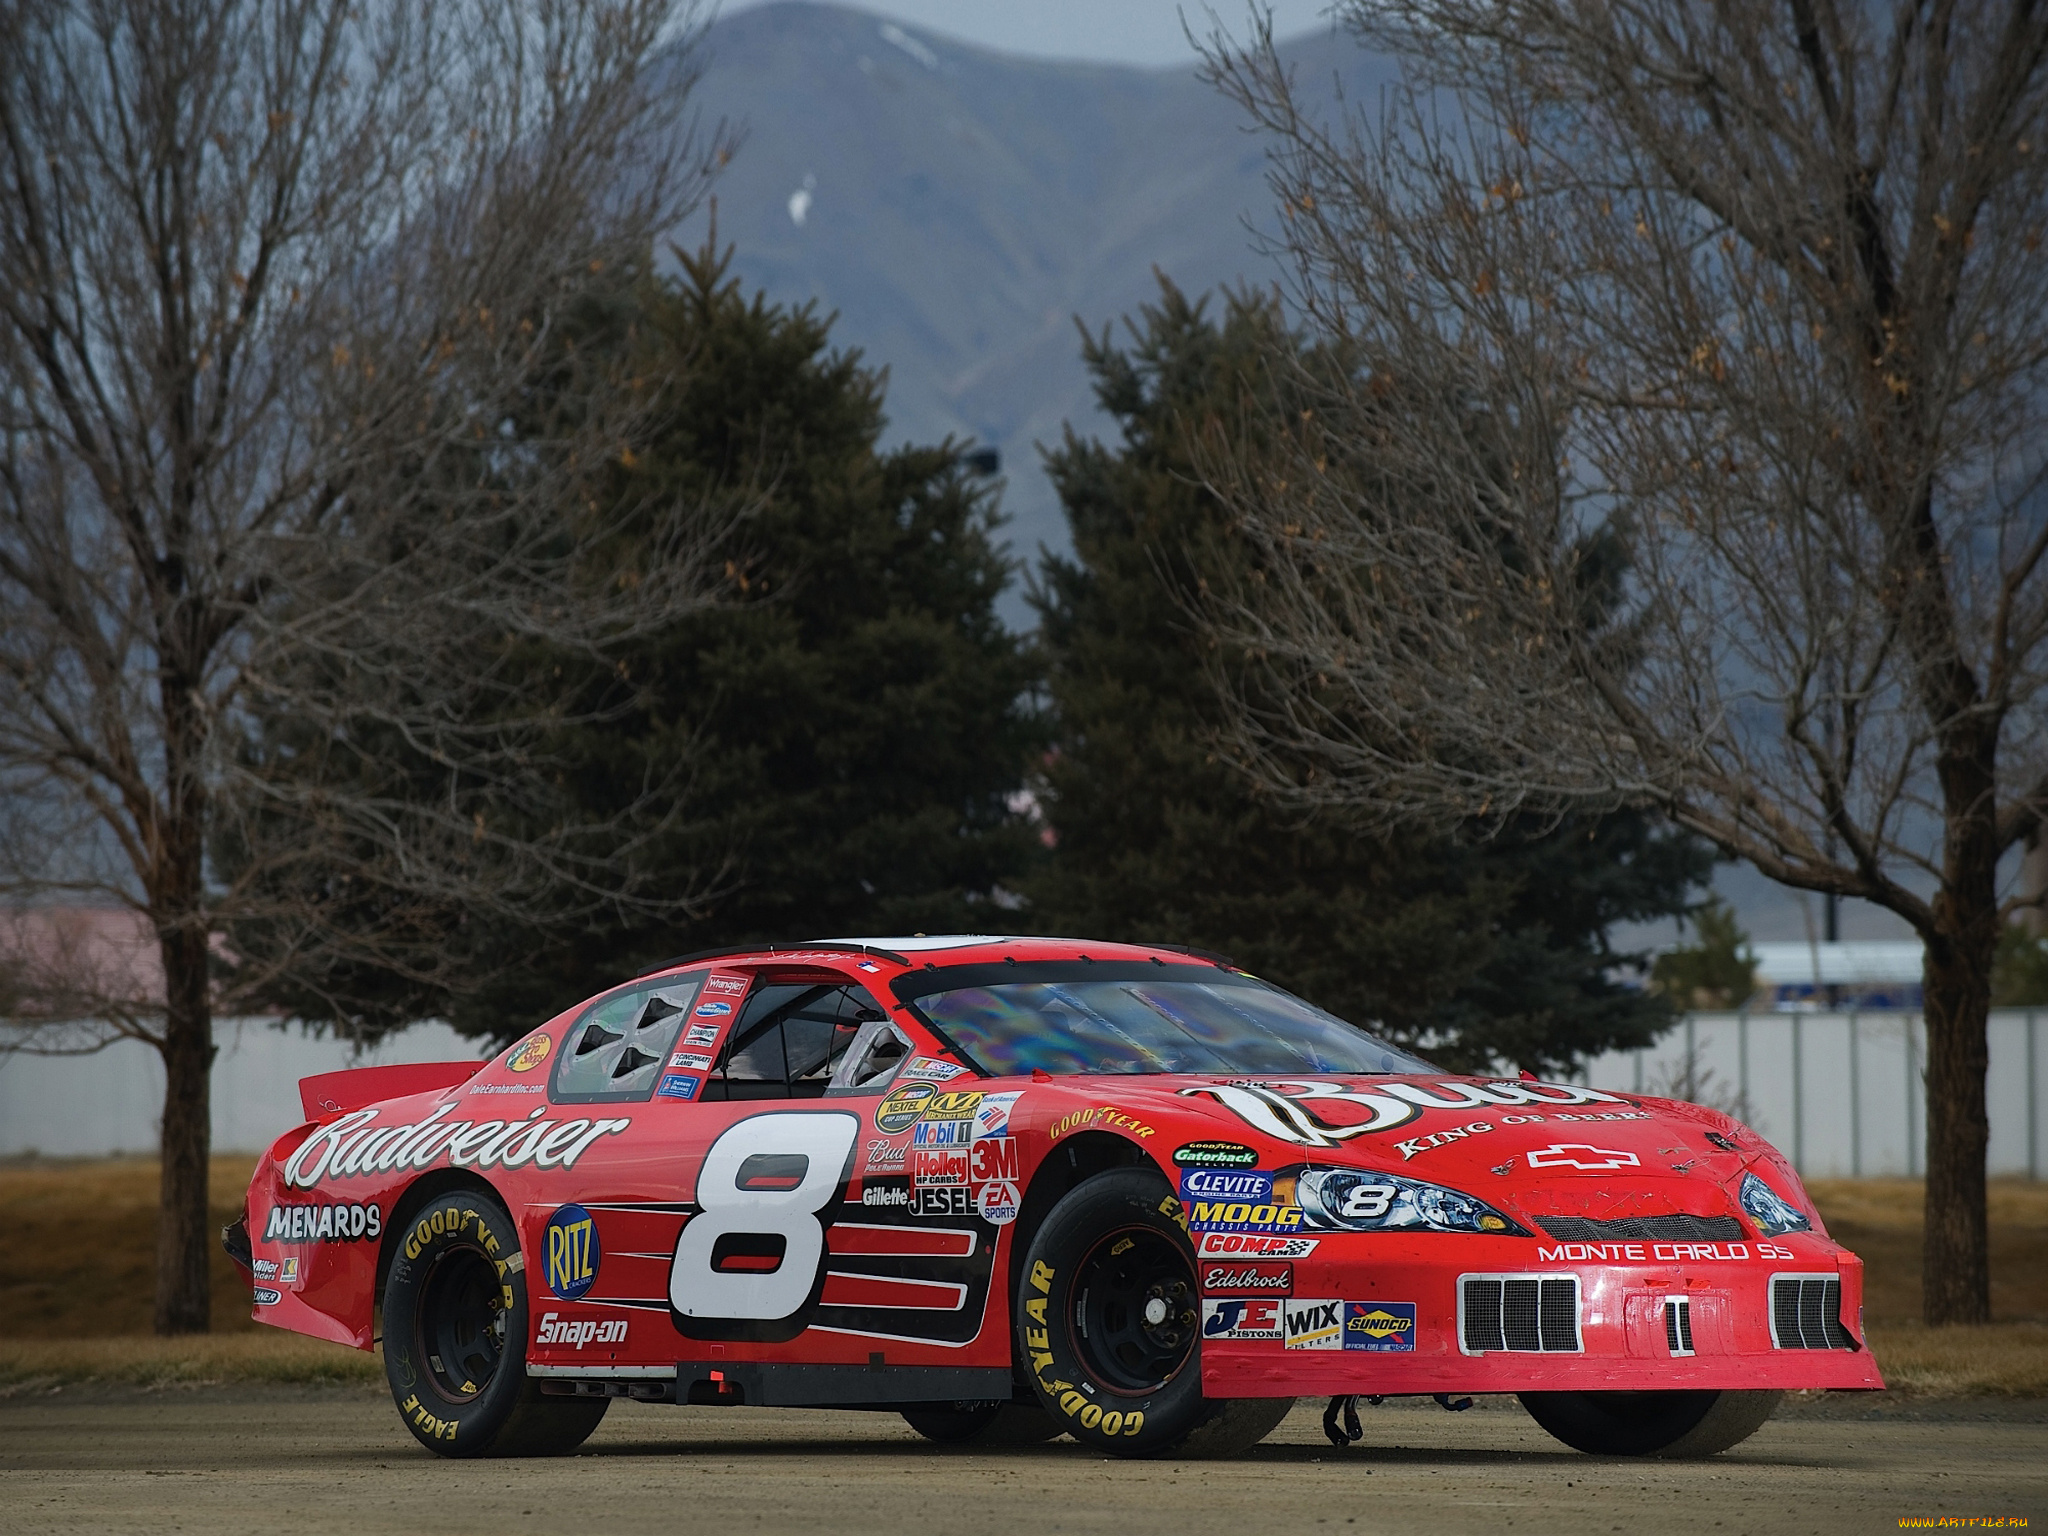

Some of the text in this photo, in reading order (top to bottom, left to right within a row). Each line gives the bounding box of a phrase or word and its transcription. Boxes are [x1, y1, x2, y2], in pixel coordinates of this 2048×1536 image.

[709, 979, 744, 992] Wrangler
[886, 1100, 919, 1113] NEXTEL
[284, 1101, 632, 1187] Budweiser
[914, 1123, 956, 1143] Mobil
[1393, 1121, 1495, 1161] KING
[1501, 1114, 1547, 1124] OF
[867, 1139, 910, 1162] Bud
[972, 1139, 1017, 1180] 3M
[1174, 1149, 1256, 1163] Gatorback
[916, 1152, 967, 1183] Holley
[929, 1176, 957, 1184] CARBS
[1187, 1171, 1266, 1193] CLEVITE
[863, 1187, 908, 1206] Gillette
[908, 1188, 979, 1215] JESEL
[985, 1183, 1014, 1206] EA
[1341, 1185, 1397, 1217] 8
[266, 1204, 381, 1239] MENARDS
[670, 1111, 860, 1321] 8
[985, 1207, 1016, 1218] SPORTS
[1190, 1202, 1303, 1225] MOOG
[1194, 1222, 1298, 1232] CHASSIS PARTS
[549, 1219, 593, 1290] RITZ
[1204, 1234, 1288, 1253] COMP
[1537, 1243, 1795, 1262] MONTE CARLO SS
[568, 1277, 592, 1289] CRACKERS
[1204, 1268, 1290, 1290] Edelbrock
[1204, 1301, 1279, 1336] JE
[1287, 1301, 1340, 1336] WIX
[1350, 1319, 1411, 1330] SUNOCO
[536, 1313, 628, 1350] Snap-on
[1228, 1330, 1282, 1338] PISTONS
[402, 1394, 460, 1440] EAGLE
